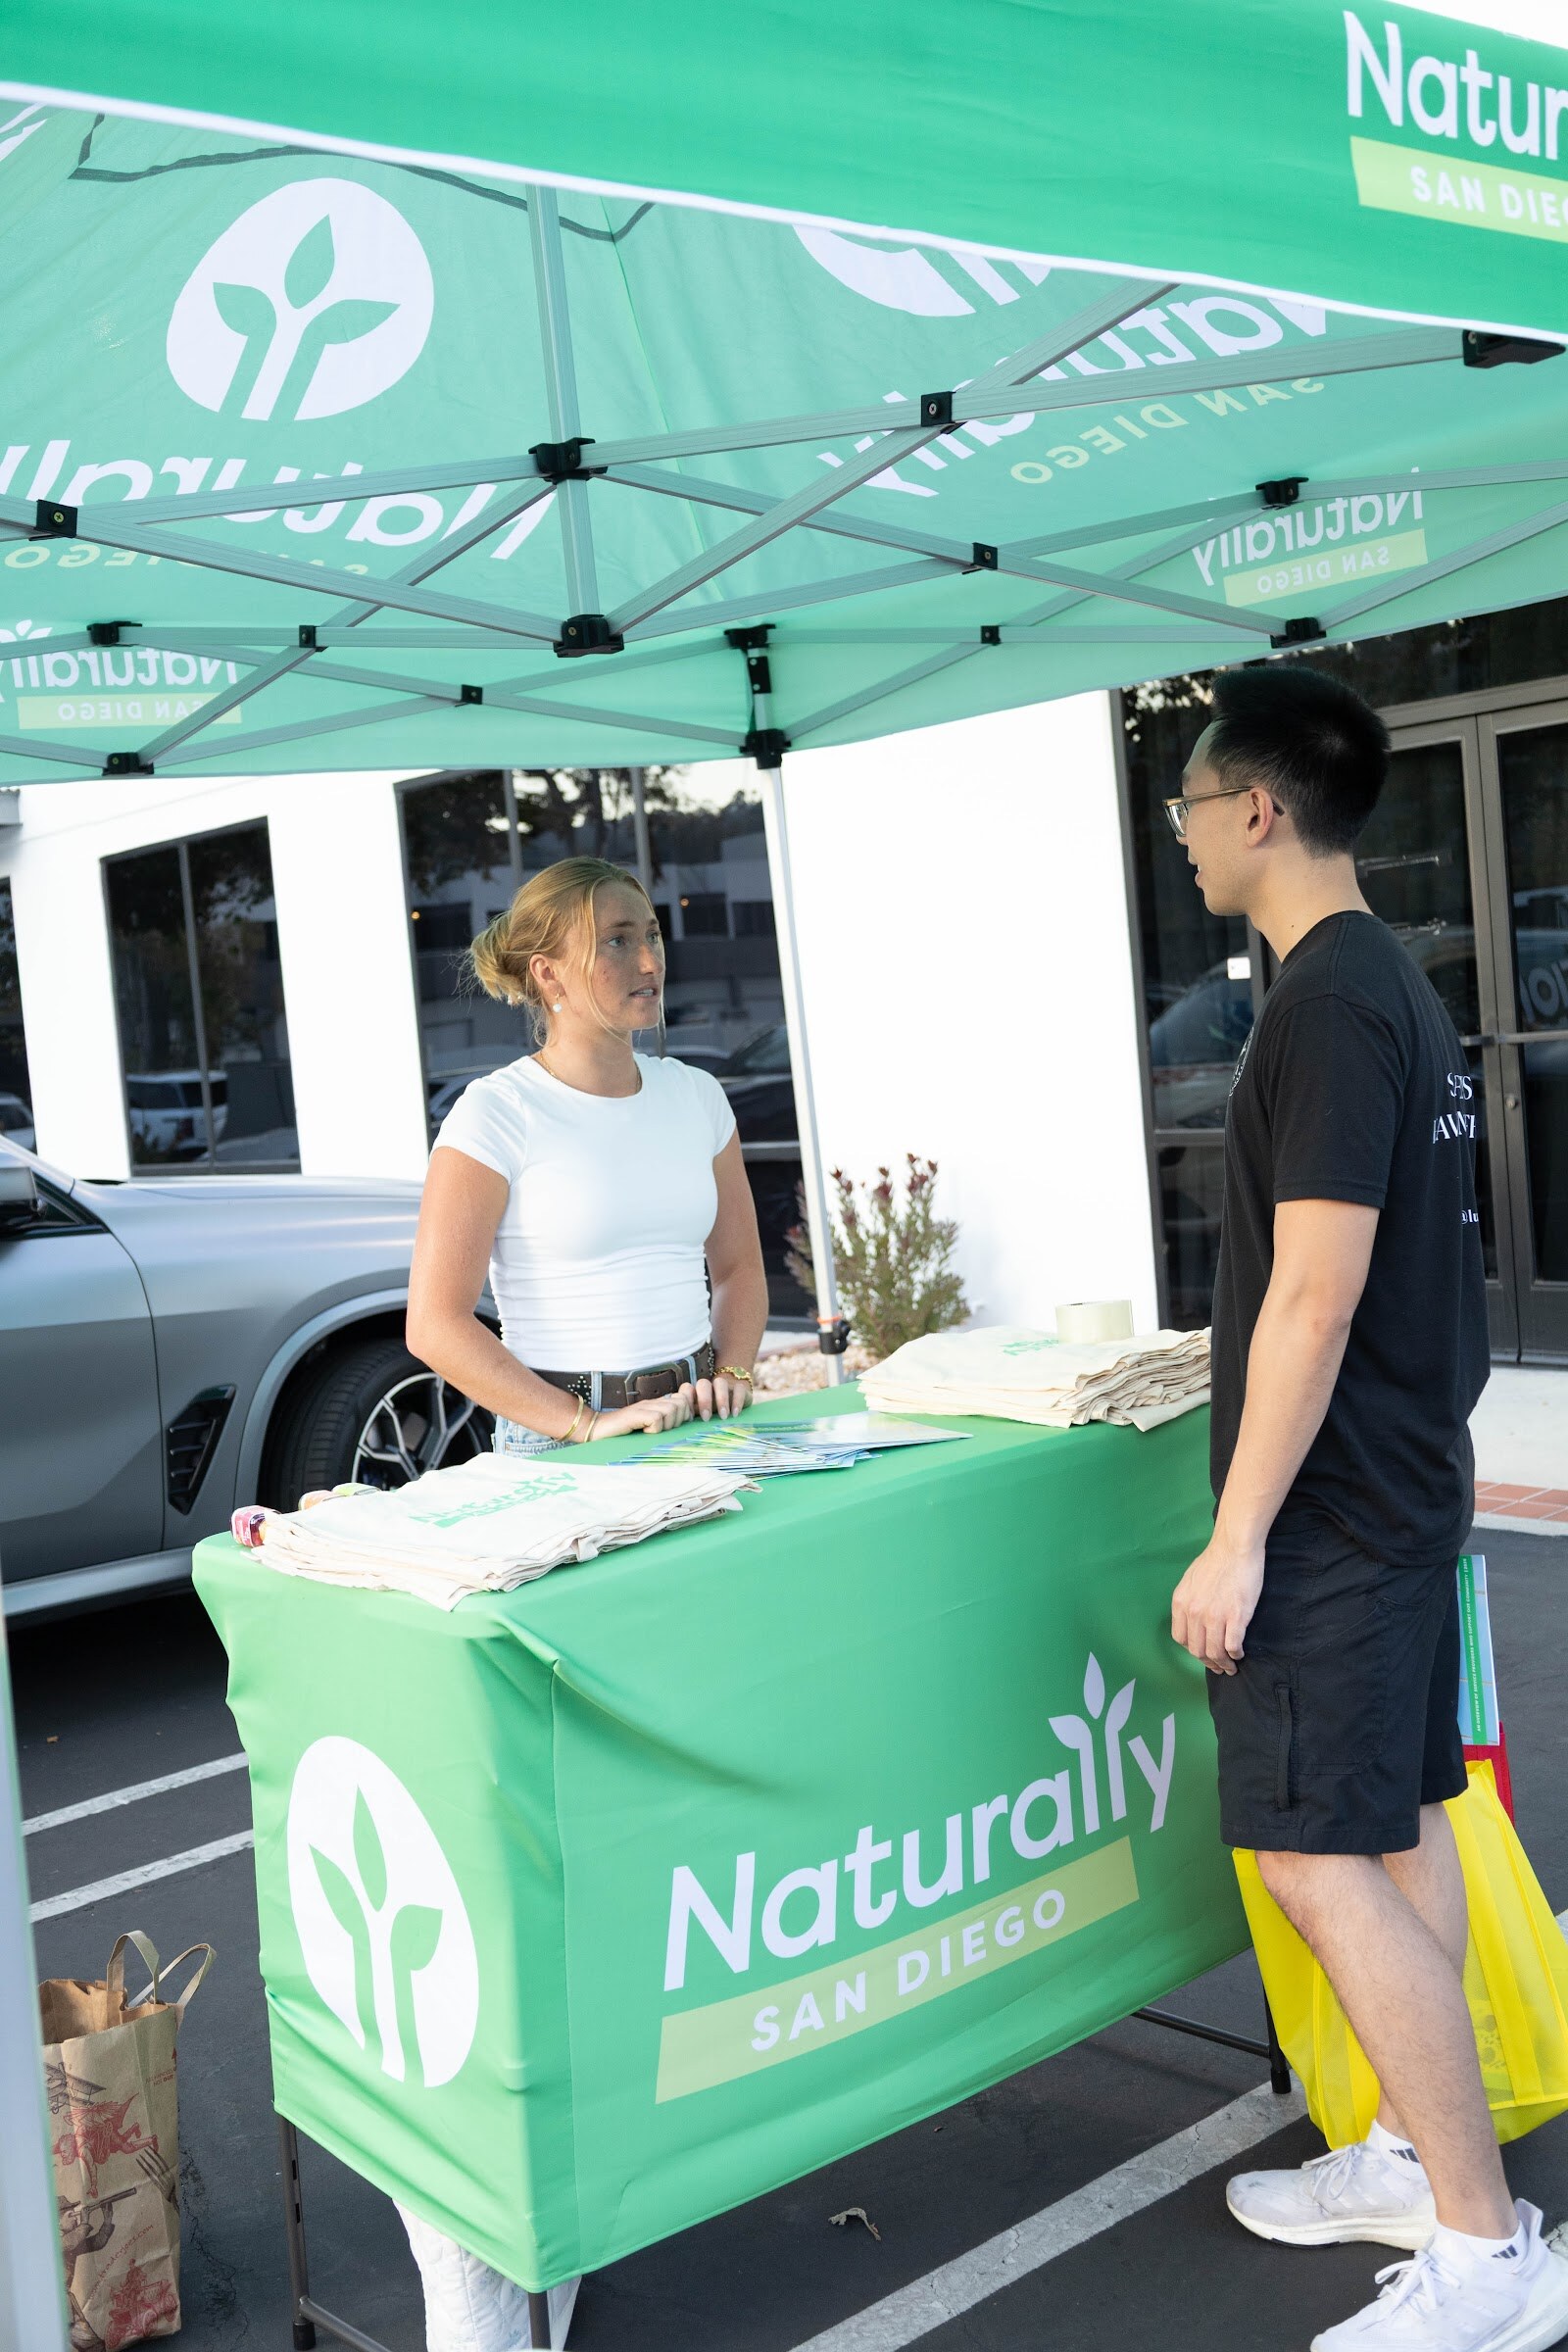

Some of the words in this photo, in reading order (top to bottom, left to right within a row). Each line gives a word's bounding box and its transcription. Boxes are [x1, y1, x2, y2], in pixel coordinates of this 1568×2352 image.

[1343, 9, 1568, 161] Natur
[1410, 165, 1487, 214] SAN
[1498, 182, 1568, 228] DIE
[663, 1651, 1176, 1991] Naturally
[751, 1971, 867, 2052] SAN
[898, 1888, 1067, 1996] DIEGO
[164, 2074, 173, 2082] OUT
